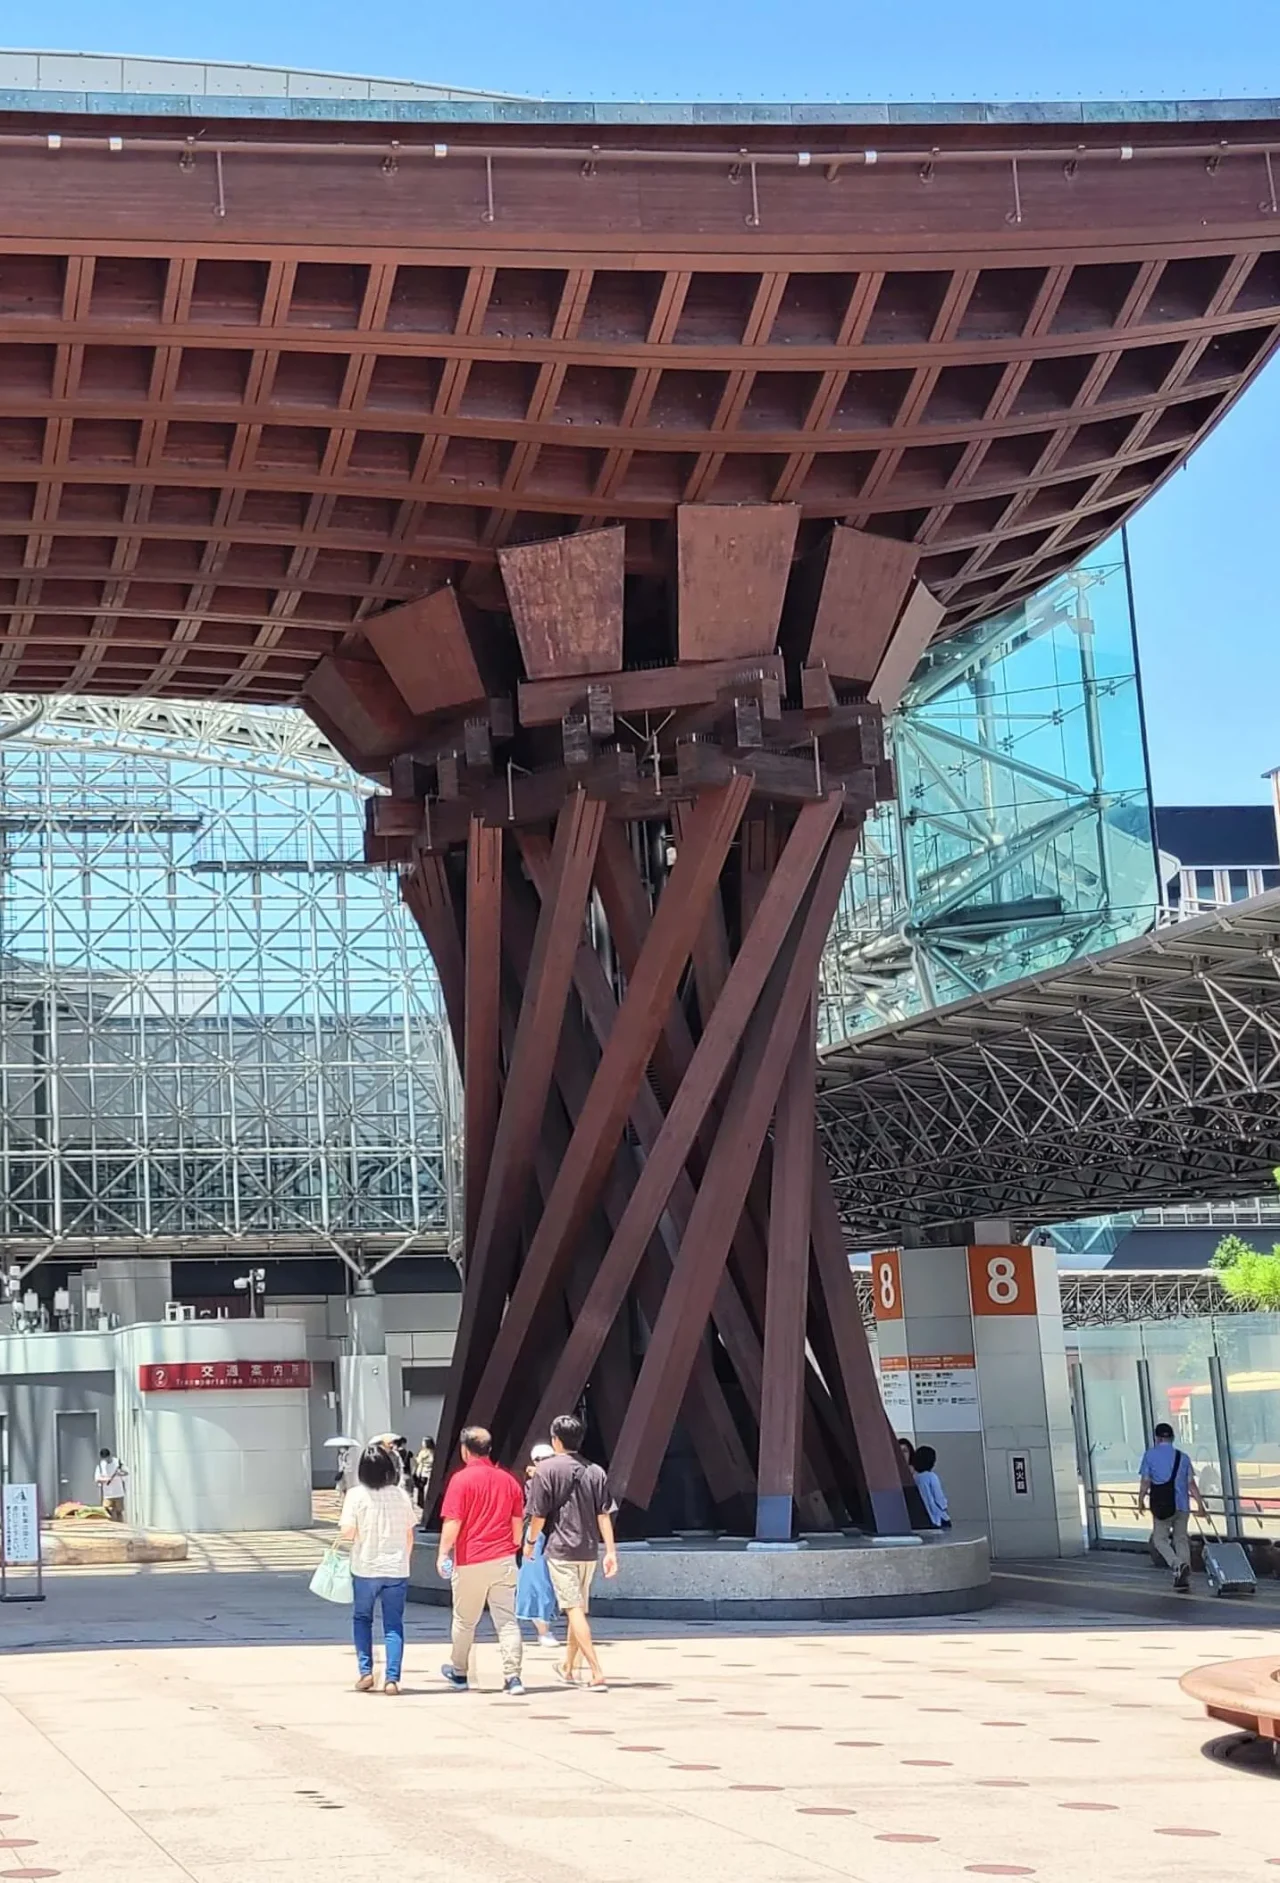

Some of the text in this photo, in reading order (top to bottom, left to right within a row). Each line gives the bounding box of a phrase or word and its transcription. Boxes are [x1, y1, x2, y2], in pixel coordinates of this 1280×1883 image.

[879, 1262, 895, 1309] 8
[987, 1256, 1019, 1304] 8
[176, 1378, 243, 1387] Transportation
[201, 1364, 299, 1378] 交通案内所
